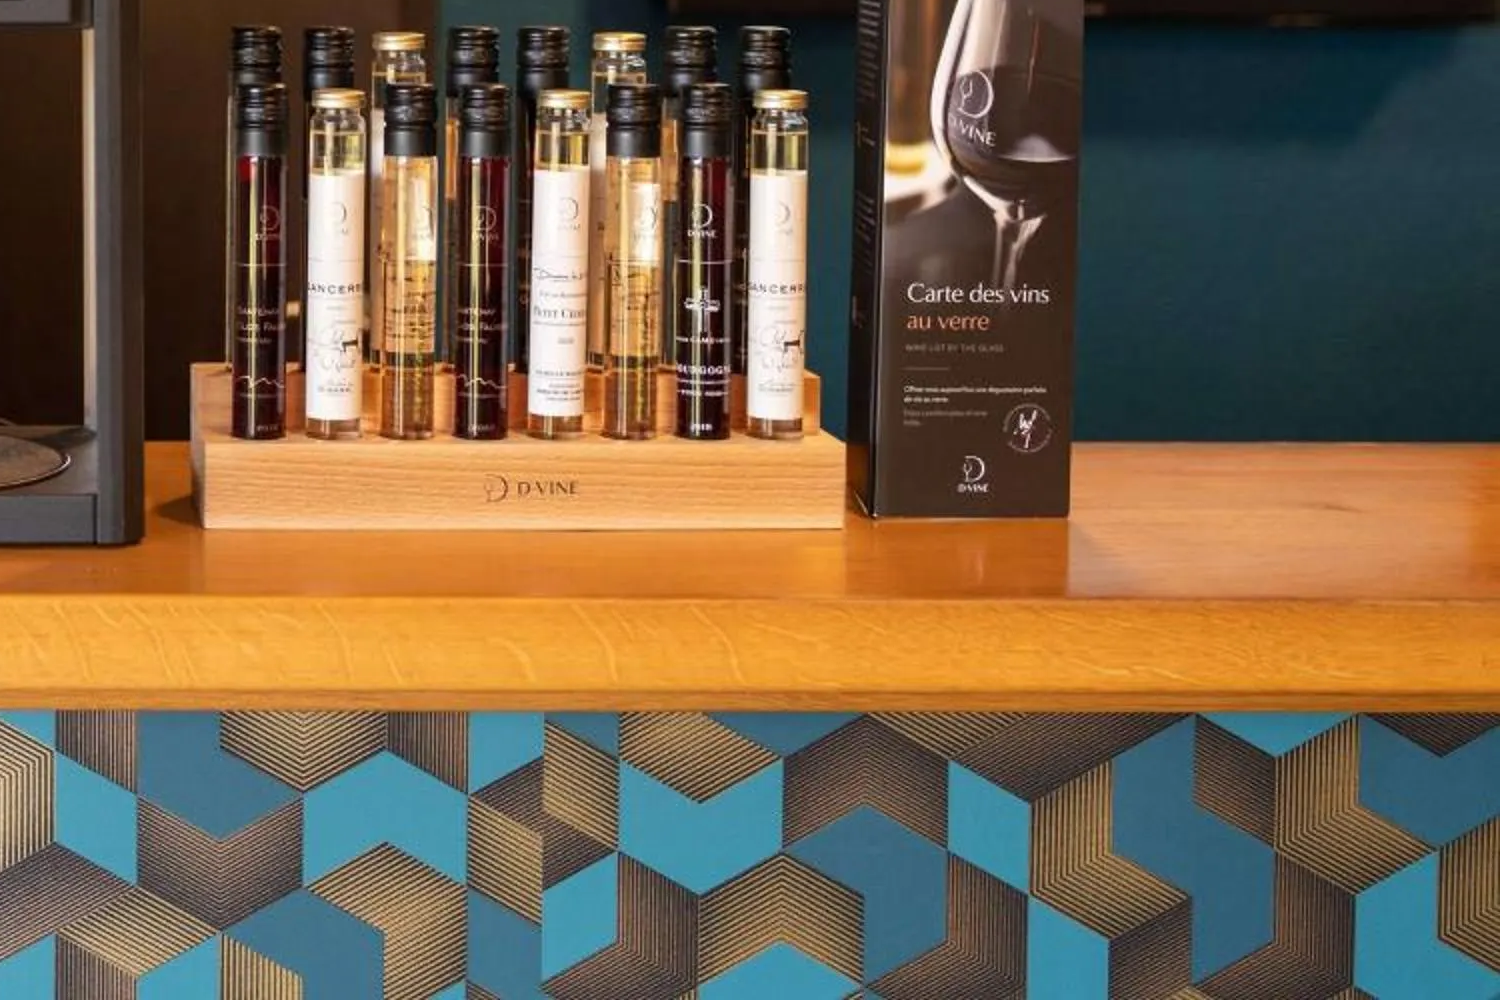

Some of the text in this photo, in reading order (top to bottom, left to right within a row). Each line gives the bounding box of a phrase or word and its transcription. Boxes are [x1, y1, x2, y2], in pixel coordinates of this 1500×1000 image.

[906, 282, 1051, 304] Carte des vins
[906, 315, 990, 331] au verre
